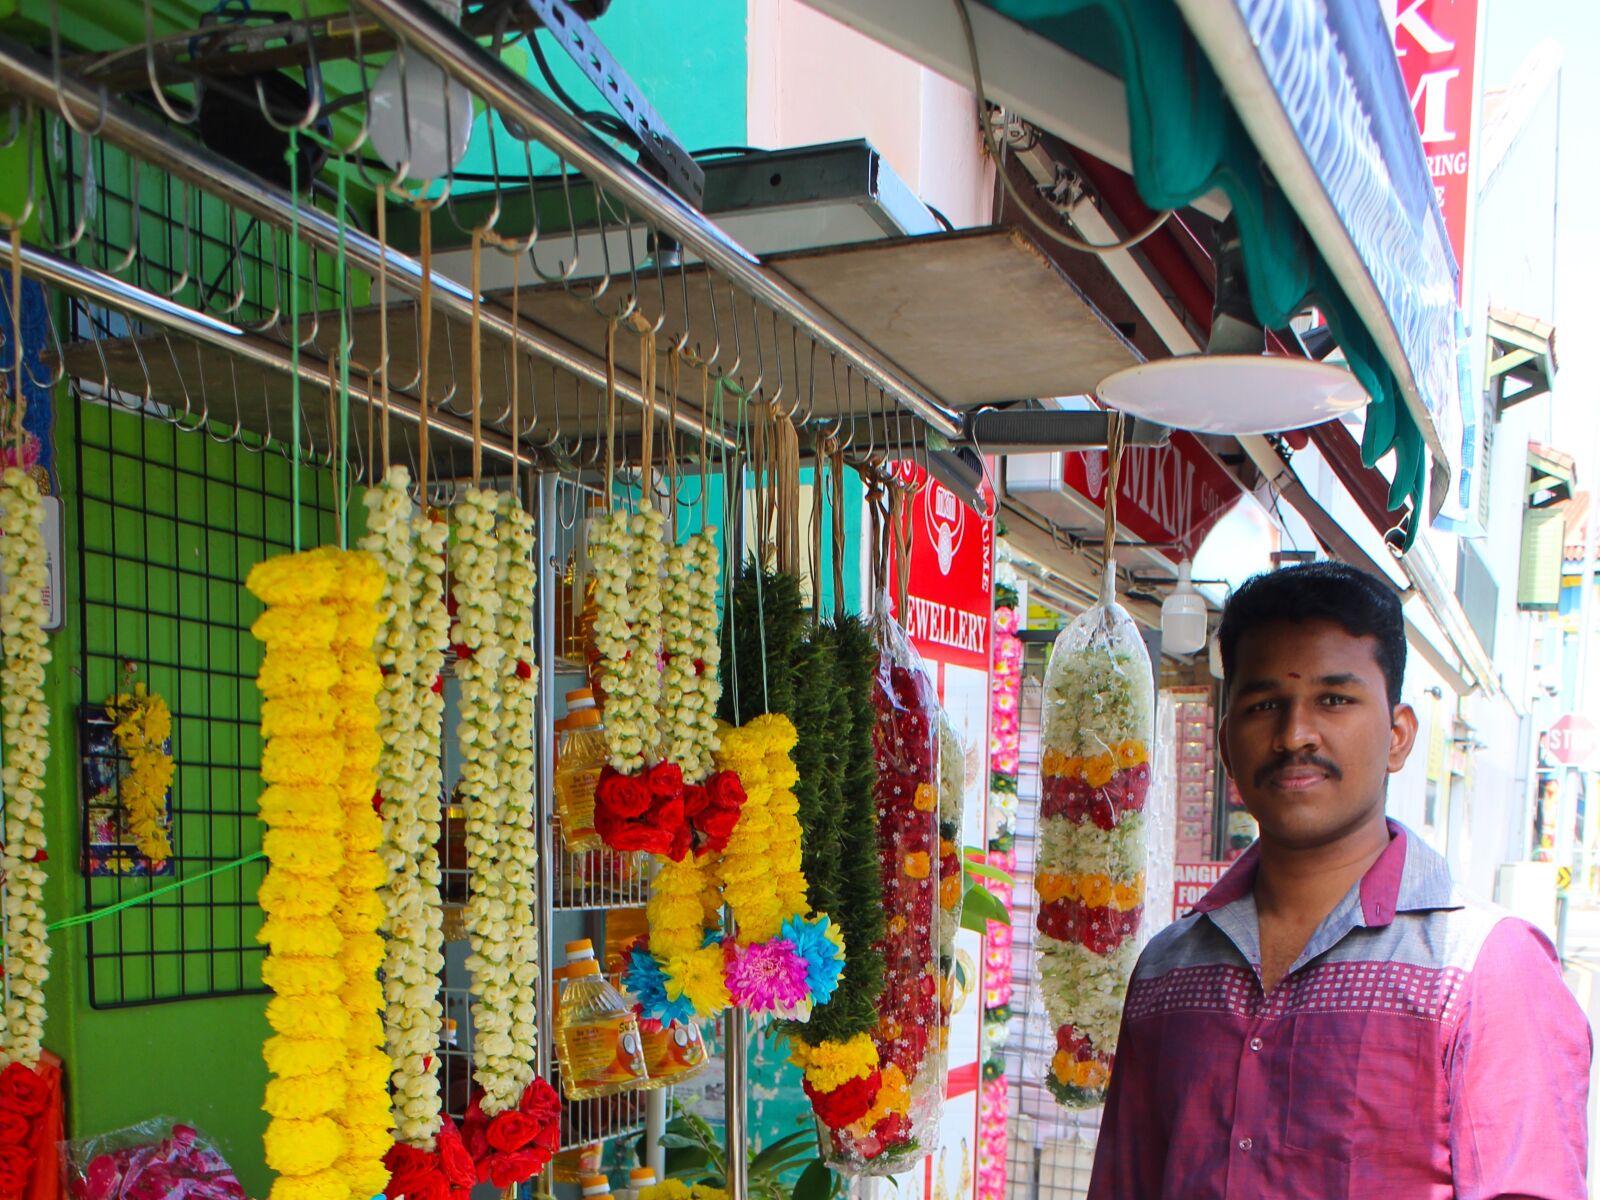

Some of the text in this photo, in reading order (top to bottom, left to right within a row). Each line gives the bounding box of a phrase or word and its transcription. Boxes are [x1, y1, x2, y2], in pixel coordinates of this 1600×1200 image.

[1426, 152, 1468, 177] RING
[1122, 443, 1196, 549] MKM
[906, 596, 987, 654] EWELLERY
